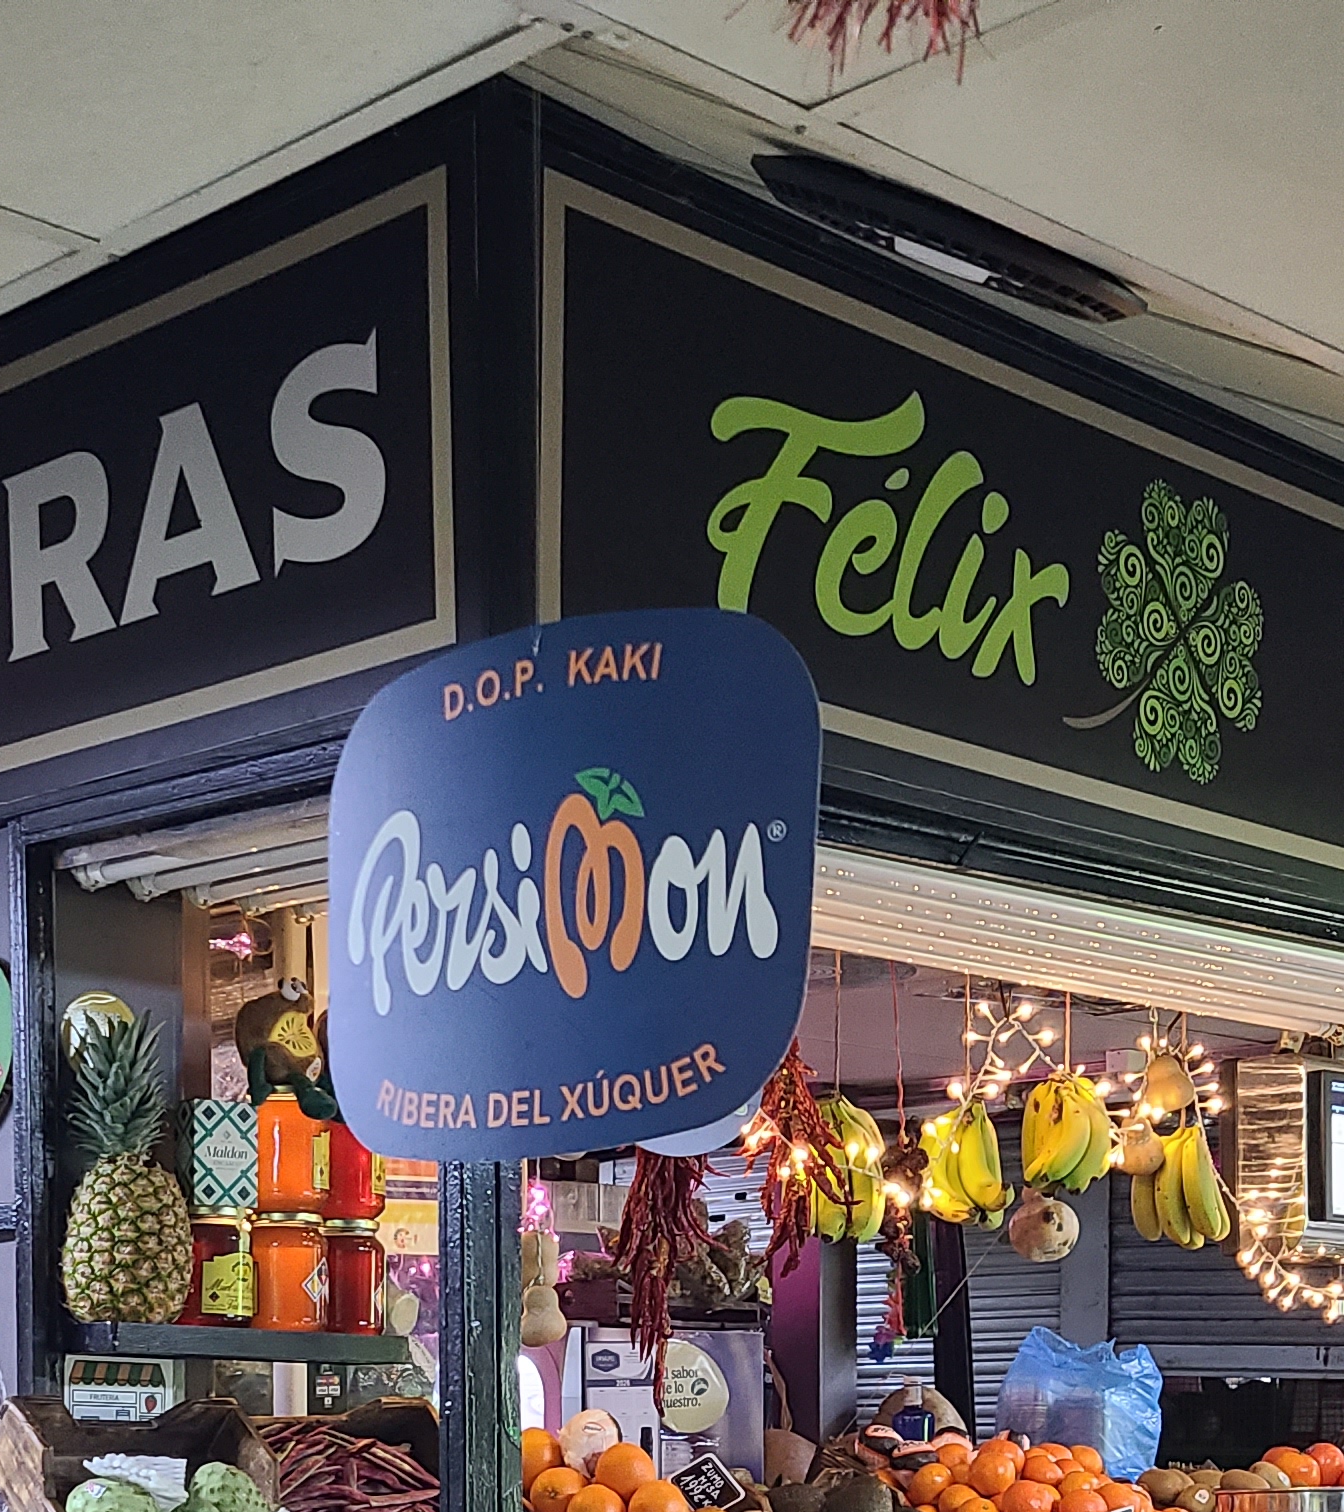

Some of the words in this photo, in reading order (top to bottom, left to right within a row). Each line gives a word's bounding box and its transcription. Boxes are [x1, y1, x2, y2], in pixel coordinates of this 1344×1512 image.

[706, 390, 1070, 686] Félix
[443, 659, 544, 721] D.O.P.
[567, 642, 663, 688] KAKI
[376, 1079, 477, 1129] RIBERA
[487, 1087, 551, 1129] DEL
[561, 1042, 726, 1122] XÚQUER
[204, 1145, 248, 1160] Maldon
[671, 1366, 699, 1380] sabor
[674, 1380, 684, 1394] lo
[701, 1461, 724, 1489] ZUMO
